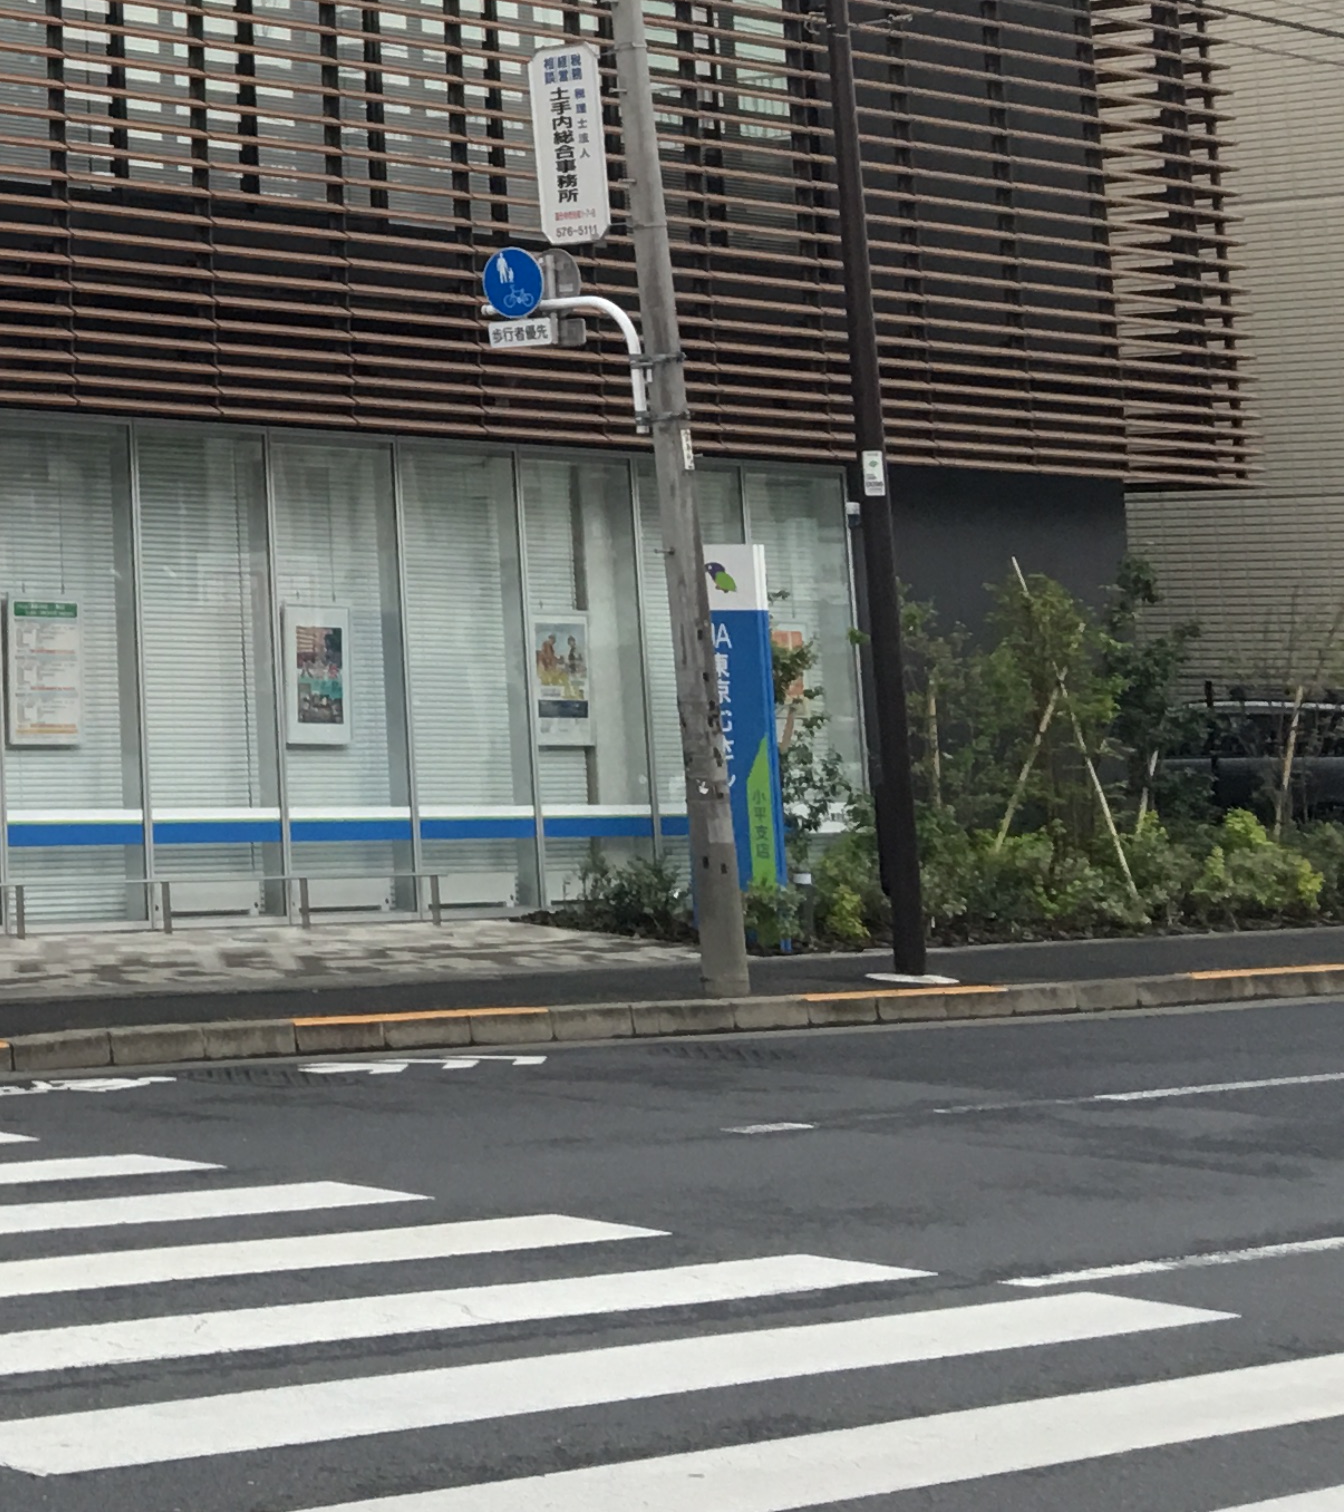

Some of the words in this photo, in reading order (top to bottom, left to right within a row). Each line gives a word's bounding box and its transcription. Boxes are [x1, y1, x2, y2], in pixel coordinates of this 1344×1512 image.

[549, 87, 579, 203] 土手内総合事務所
[492, 324, 549, 343] 歩行者優先
[752, 788, 770, 859] 小平支店
